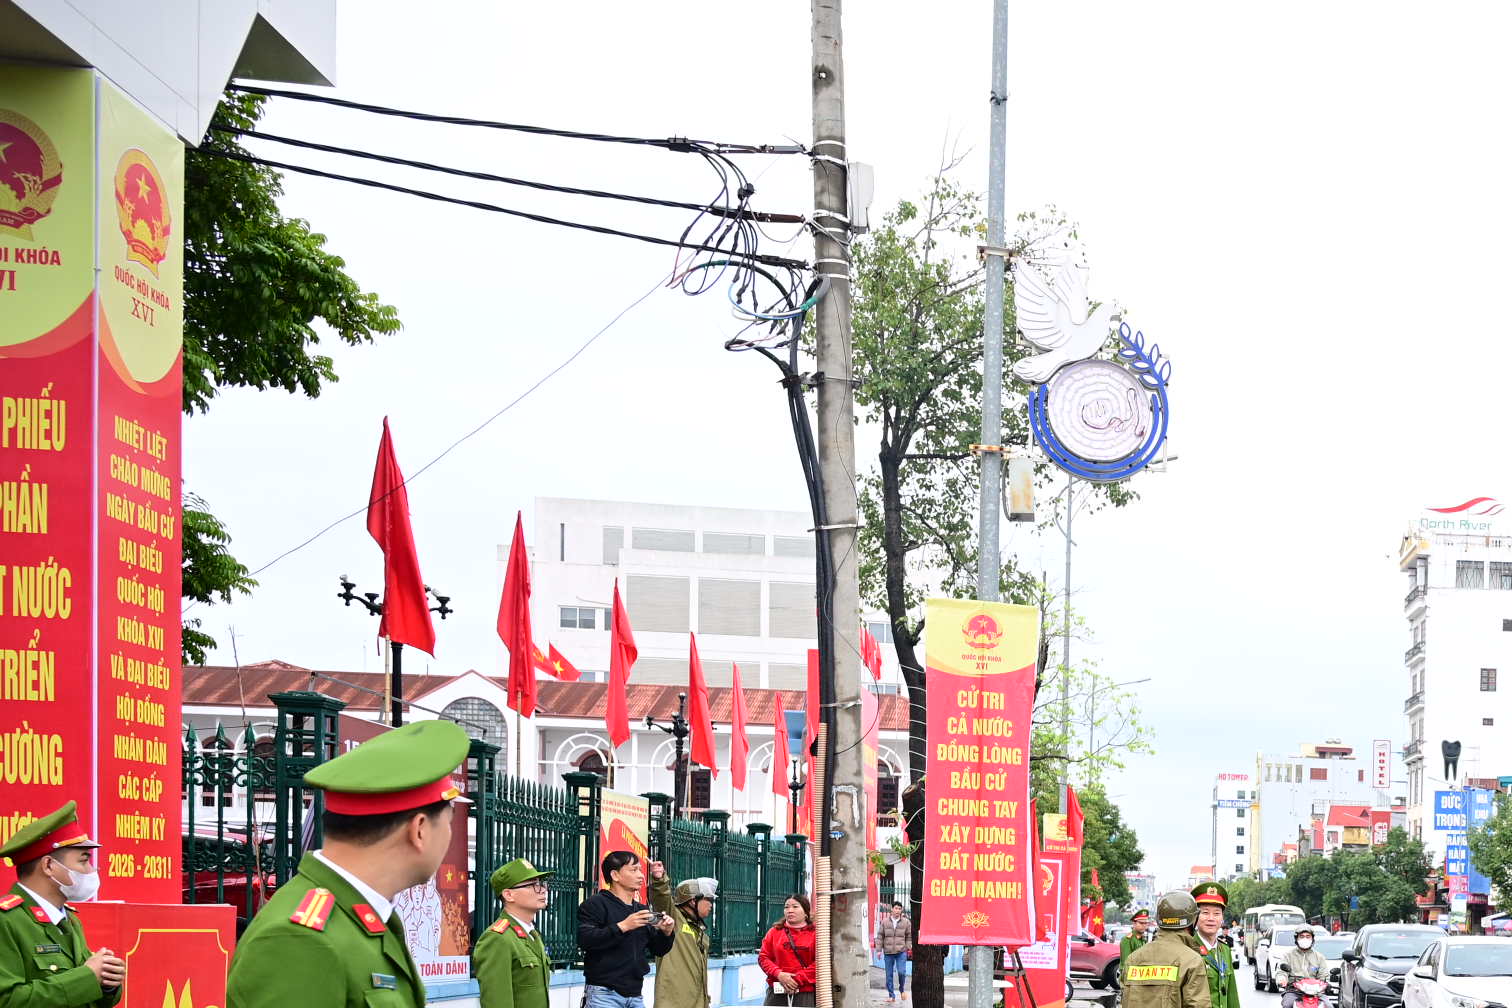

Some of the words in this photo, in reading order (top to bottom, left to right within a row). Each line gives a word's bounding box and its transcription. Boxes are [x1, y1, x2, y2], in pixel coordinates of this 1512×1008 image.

[14, 246, 61, 266] KHÓA
[114, 265, 134, 289] QUỐC
[137, 278, 149, 299] HỘI
[151, 287, 170, 311] KHÓA
[131, 296, 154, 327] XVI
[2, 382, 67, 452] PHIẾU
[114, 415, 145, 454] NHIỆT
[147, 430, 168, 464] LIỆT
[110, 453, 138, 488] CHÀO
[141, 465, 171, 501] MỪNG
[106, 492, 136, 525] NGÀY
[138, 500, 158, 534] BẦU
[160, 507, 175, 540] CỬ
[1420, 517, 1455, 530] North
[1459, 519, 1493, 531] River
[119, 537, 137, 570] ĐẠI
[139, 540, 163, 574] BIỂU
[13, 556, 72, 619] NƯỚC
[117, 574, 145, 607] QUỐC
[147, 584, 165, 616] HỘI
[117, 615, 146, 647] KHÓA
[147, 624, 164, 651] XVI
[111, 651, 125, 680] VÀ
[127, 658, 145, 688] ĐẠI
[147, 657, 170, 690] BIỂU
[975, 662, 988, 670] XVI
[116, 692, 134, 725] HỘI
[137, 694, 166, 728] ĐỒNG
[957, 685, 979, 708] CỬ
[982, 690, 1005, 710] TRI
[947, 711, 968, 735] CẢ
[973, 716, 1013, 737] NƯỚC
[114, 732, 144, 762] NHÂN
[146, 736, 167, 766] DÂN
[936, 738, 980, 762] ĐỒNG
[983, 742, 1022, 765] LÒNG
[950, 766, 981, 790] BẦU
[985, 768, 1008, 791] CỬ
[1378, 751, 1386, 785] HOTEL
[118, 770, 140, 801] CÁC
[142, 771, 163, 803] CẤP
[937, 798, 989, 817] CHUNG
[994, 801, 1018, 818] TAY
[1436, 813, 1467, 830] TRỌNG
[116, 810, 151, 844] NHIỆM
[153, 813, 166, 841] KỲ
[939, 822, 971, 843] XÂY
[975, 826, 1016, 848] DỰNG
[108, 853, 135, 878] 2026
[144, 855, 172, 879] 2031!
[940, 847, 969, 871] ĐẤT
[973, 851, 1014, 872] NƯỚC
[931, 876, 967, 898] GIÀU
[971, 880, 1022, 902] MẠNH!
[420, 960, 443, 976] TOÀN
[445, 961, 467, 976] DÂN!
